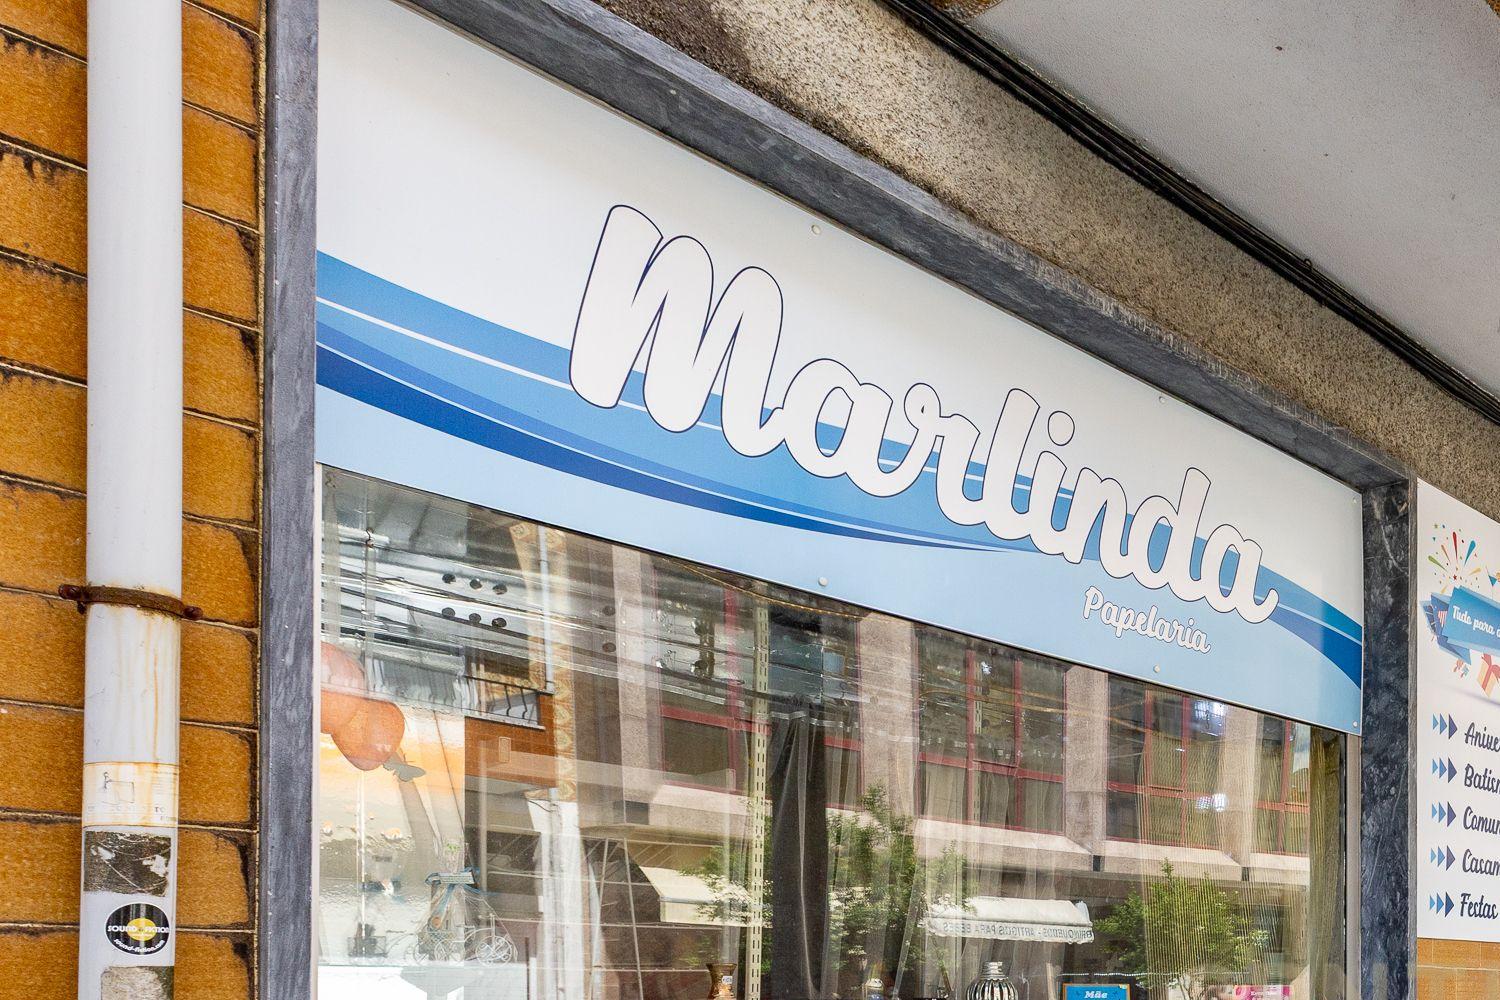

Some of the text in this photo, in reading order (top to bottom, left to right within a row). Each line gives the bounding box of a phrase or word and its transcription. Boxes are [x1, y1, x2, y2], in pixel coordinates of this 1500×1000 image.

[569, 205, 1280, 625] Marlinda
[1082, 584, 1212, 654] Papelaria
[1452, 605, 1472, 625] Tudo
[1473, 618, 1495, 636] para
[1460, 892, 1499, 920] Festas
[1084, 990, 1108, 999] Mãe
